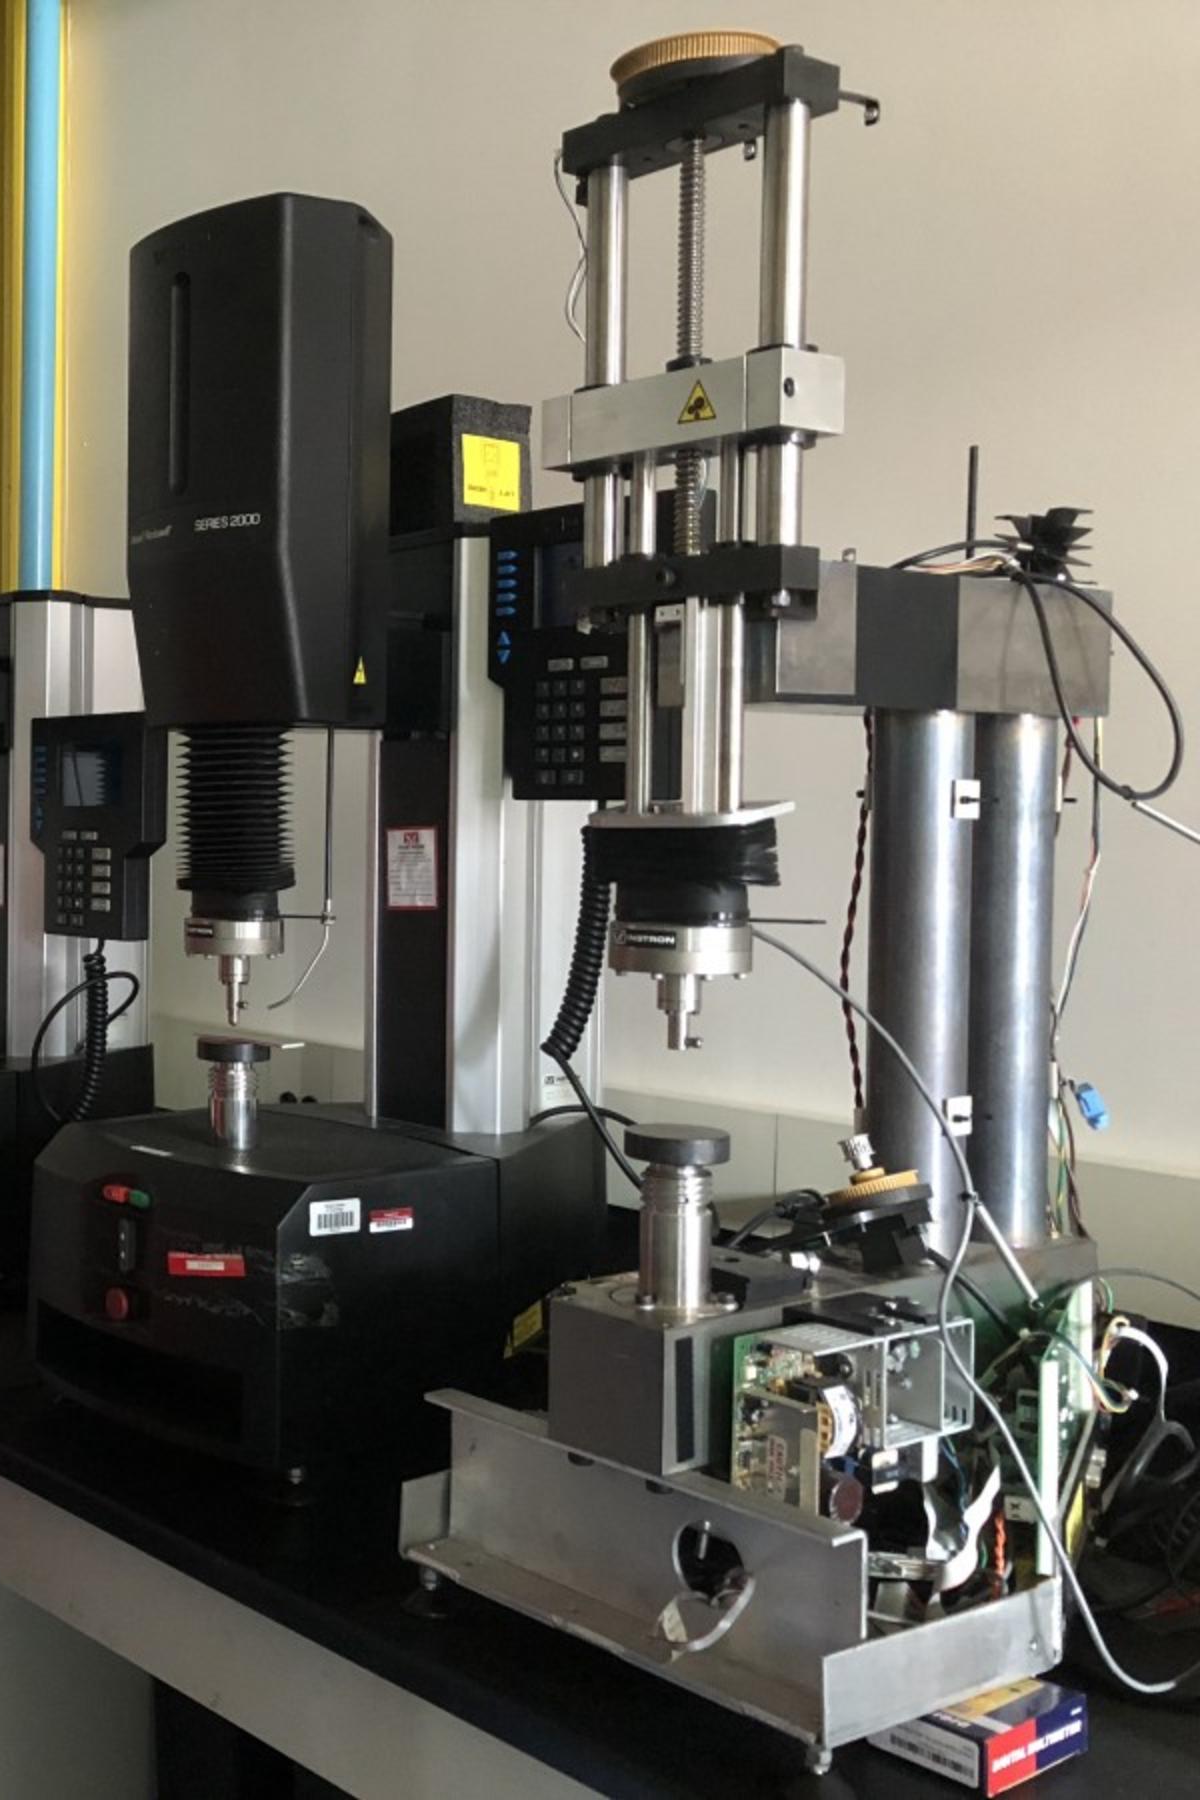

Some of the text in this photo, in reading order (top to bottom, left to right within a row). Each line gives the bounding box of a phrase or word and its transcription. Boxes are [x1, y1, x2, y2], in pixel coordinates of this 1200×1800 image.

[193, 512, 261, 532] SERIES 2000
[992, 1747, 1027, 1773] DIGITAL
